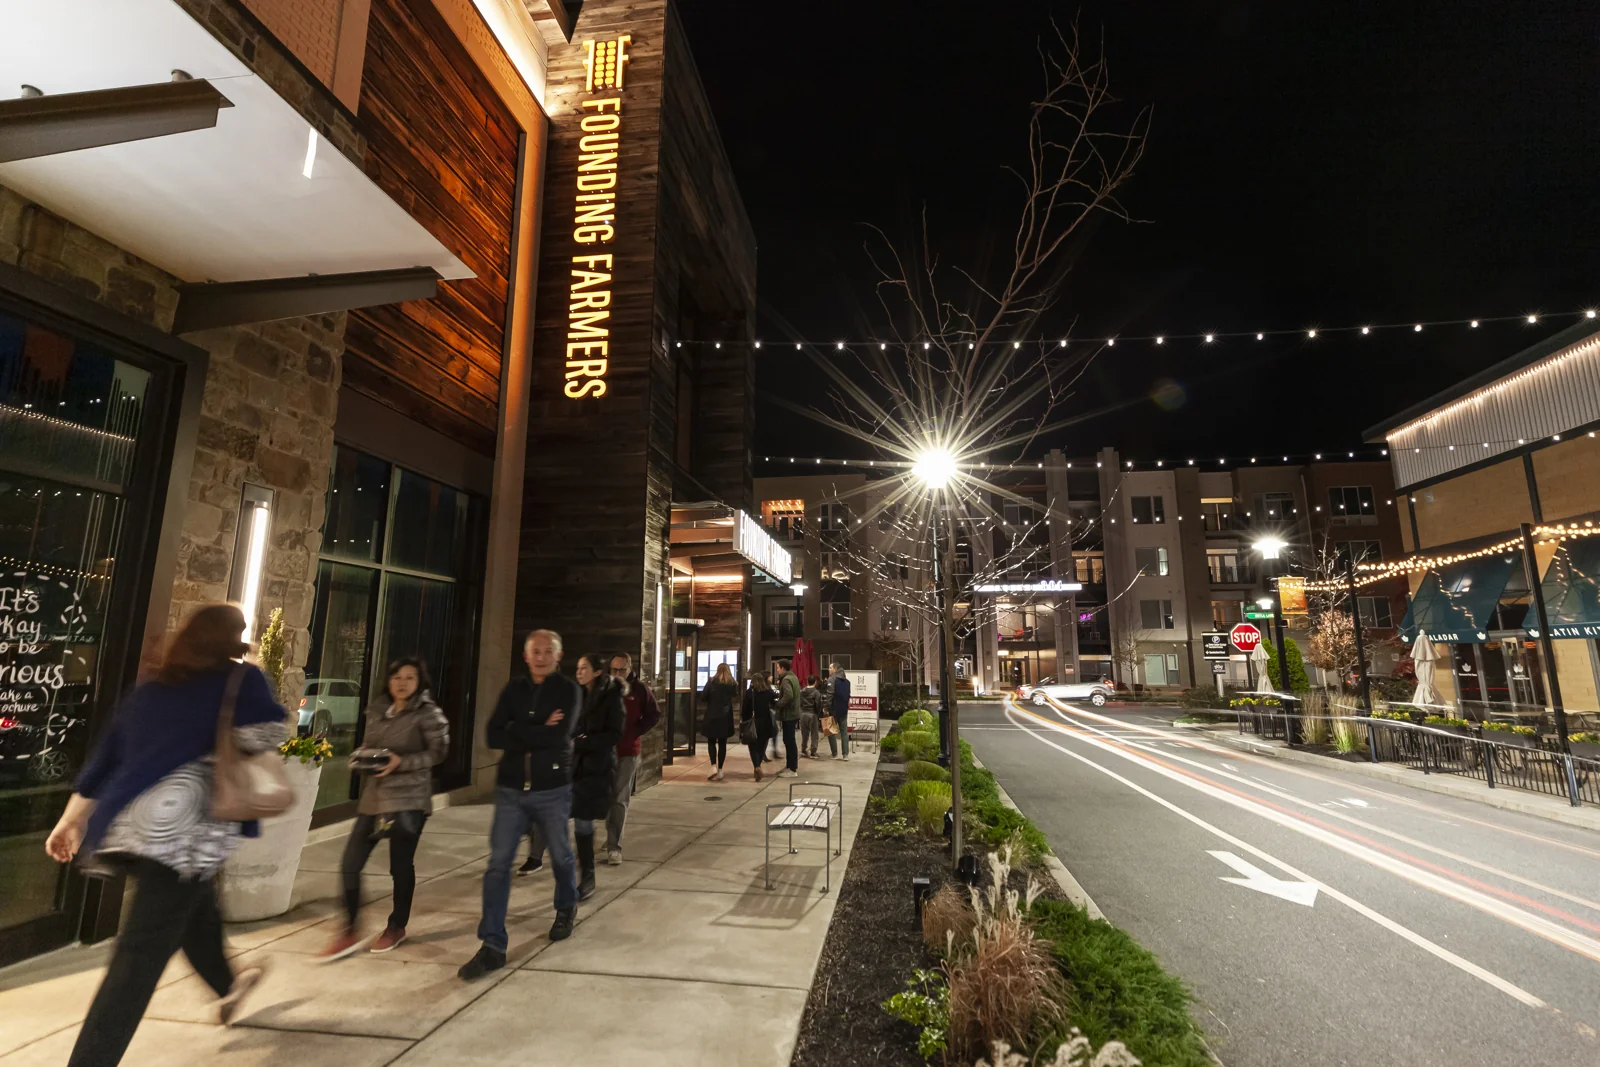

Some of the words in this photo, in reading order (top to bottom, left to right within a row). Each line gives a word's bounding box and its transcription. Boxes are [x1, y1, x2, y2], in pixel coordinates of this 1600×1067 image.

[573, 97, 621, 245] FOUNDING
[564, 254, 613, 399] FARMERS
[1233, 632, 1259, 643] STOP
[1428, 633, 1459, 642] ALADAR
[1549, 627, 1580, 637] ATIN
[18, 638, 44, 654] be
[0, 688, 22, 703] ake
